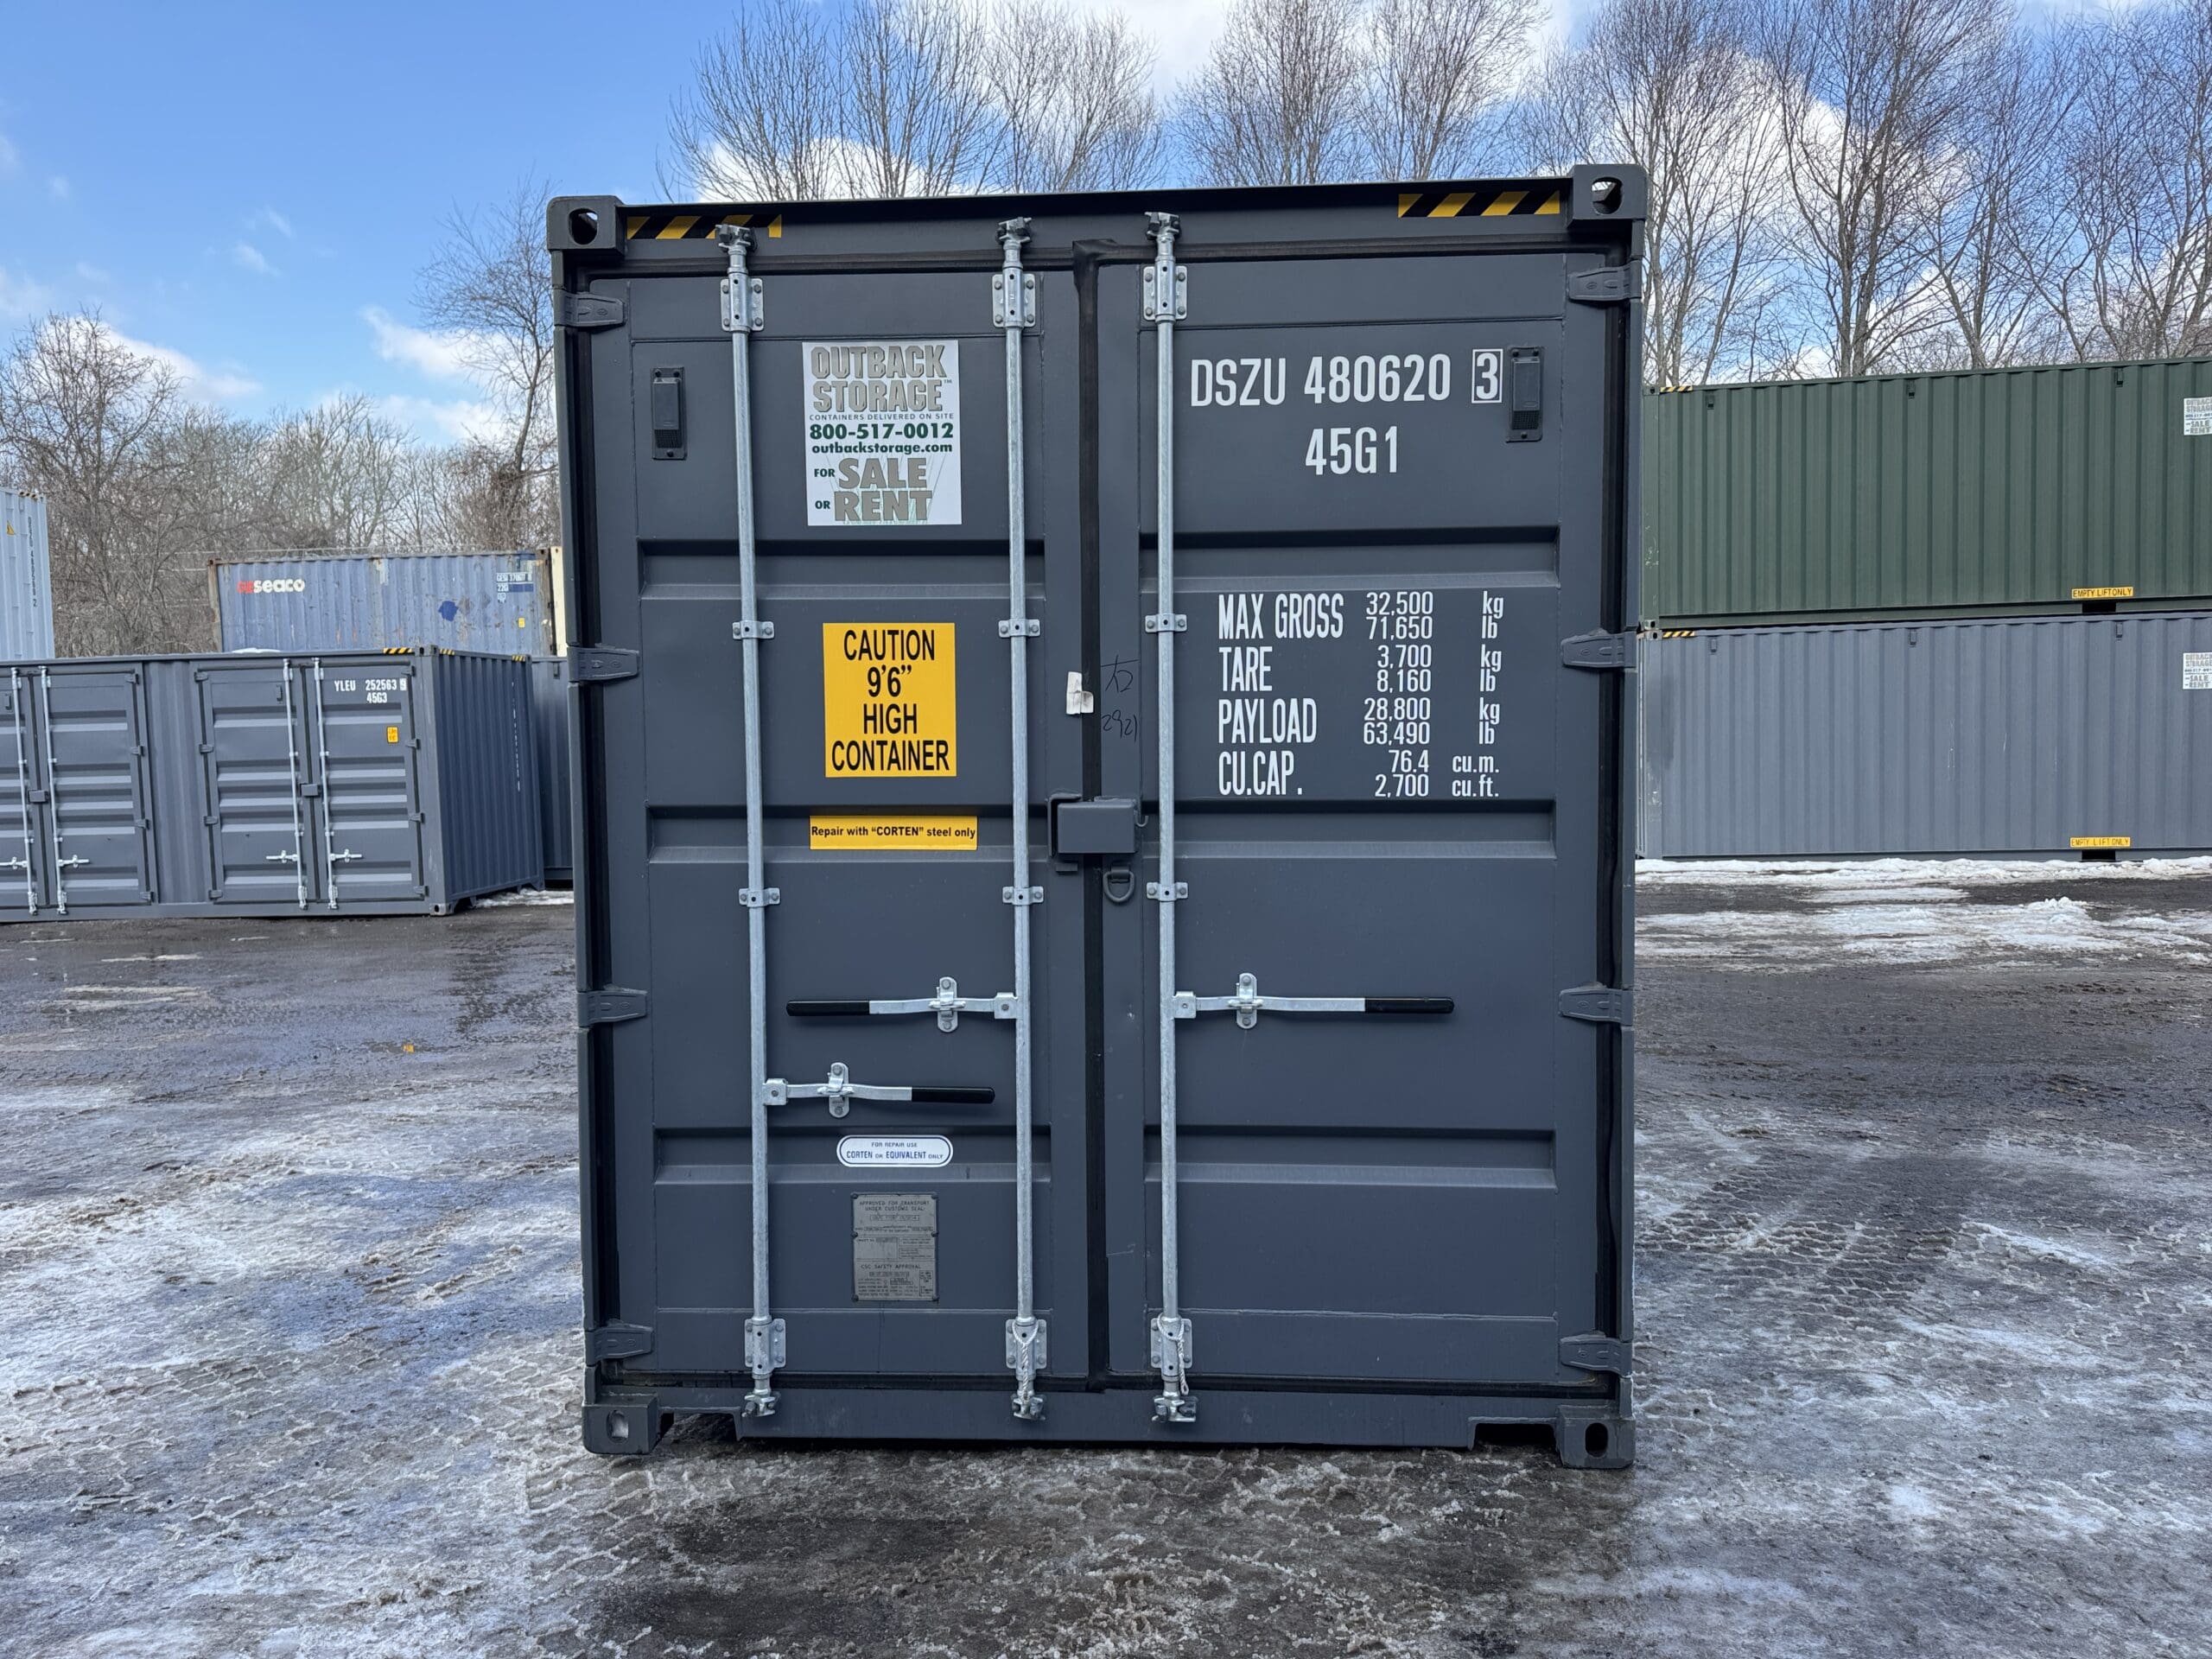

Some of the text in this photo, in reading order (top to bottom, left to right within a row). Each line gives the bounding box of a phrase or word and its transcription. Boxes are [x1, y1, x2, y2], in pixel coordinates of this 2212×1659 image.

[810, 345, 947, 378] OUTBACK
[1190, 352, 1499, 407] DSZU 480620 3
[812, 379, 943, 412] STORAGE
[810, 423, 954, 440] 800-517-0012
[811, 442, 953, 454] outbackstorage.com
[1305, 426, 1397, 475] 45G1
[814, 458, 927, 489] FOR SALE
[815, 491, 932, 521] OR RENT
[2112, 588, 2132, 596] ONLY
[1218, 590, 1504, 639] MAX GROSS 32,500 kg
[1365, 615, 1497, 639] 71,650 lb
[843, 629, 935, 661] CAUTION
[1218, 644, 1502, 691] TARE 3,700 kg
[1376, 669, 1496, 693] 8,160 lb
[334, 680, 356, 691] YLEU
[365, 678, 397, 690] 252563
[863, 703, 918, 734] HIGH
[1218, 697, 1500, 744] PAYLOAD 28,800 kg
[1363, 721, 1494, 746] 63,490 lb
[831, 740, 950, 771] CONTAINER
[1388, 749, 1429, 773] 76.4
[1452, 754, 1499, 773] cu.m.
[1375, 773, 1499, 798] 2,700 cu.ft.
[811, 826, 843, 838] Repair
[847, 826, 868, 836] with
[926, 827, 951, 837] steel
[954, 827, 976, 839] only
[846, 1150, 873, 1159] CORTEN
